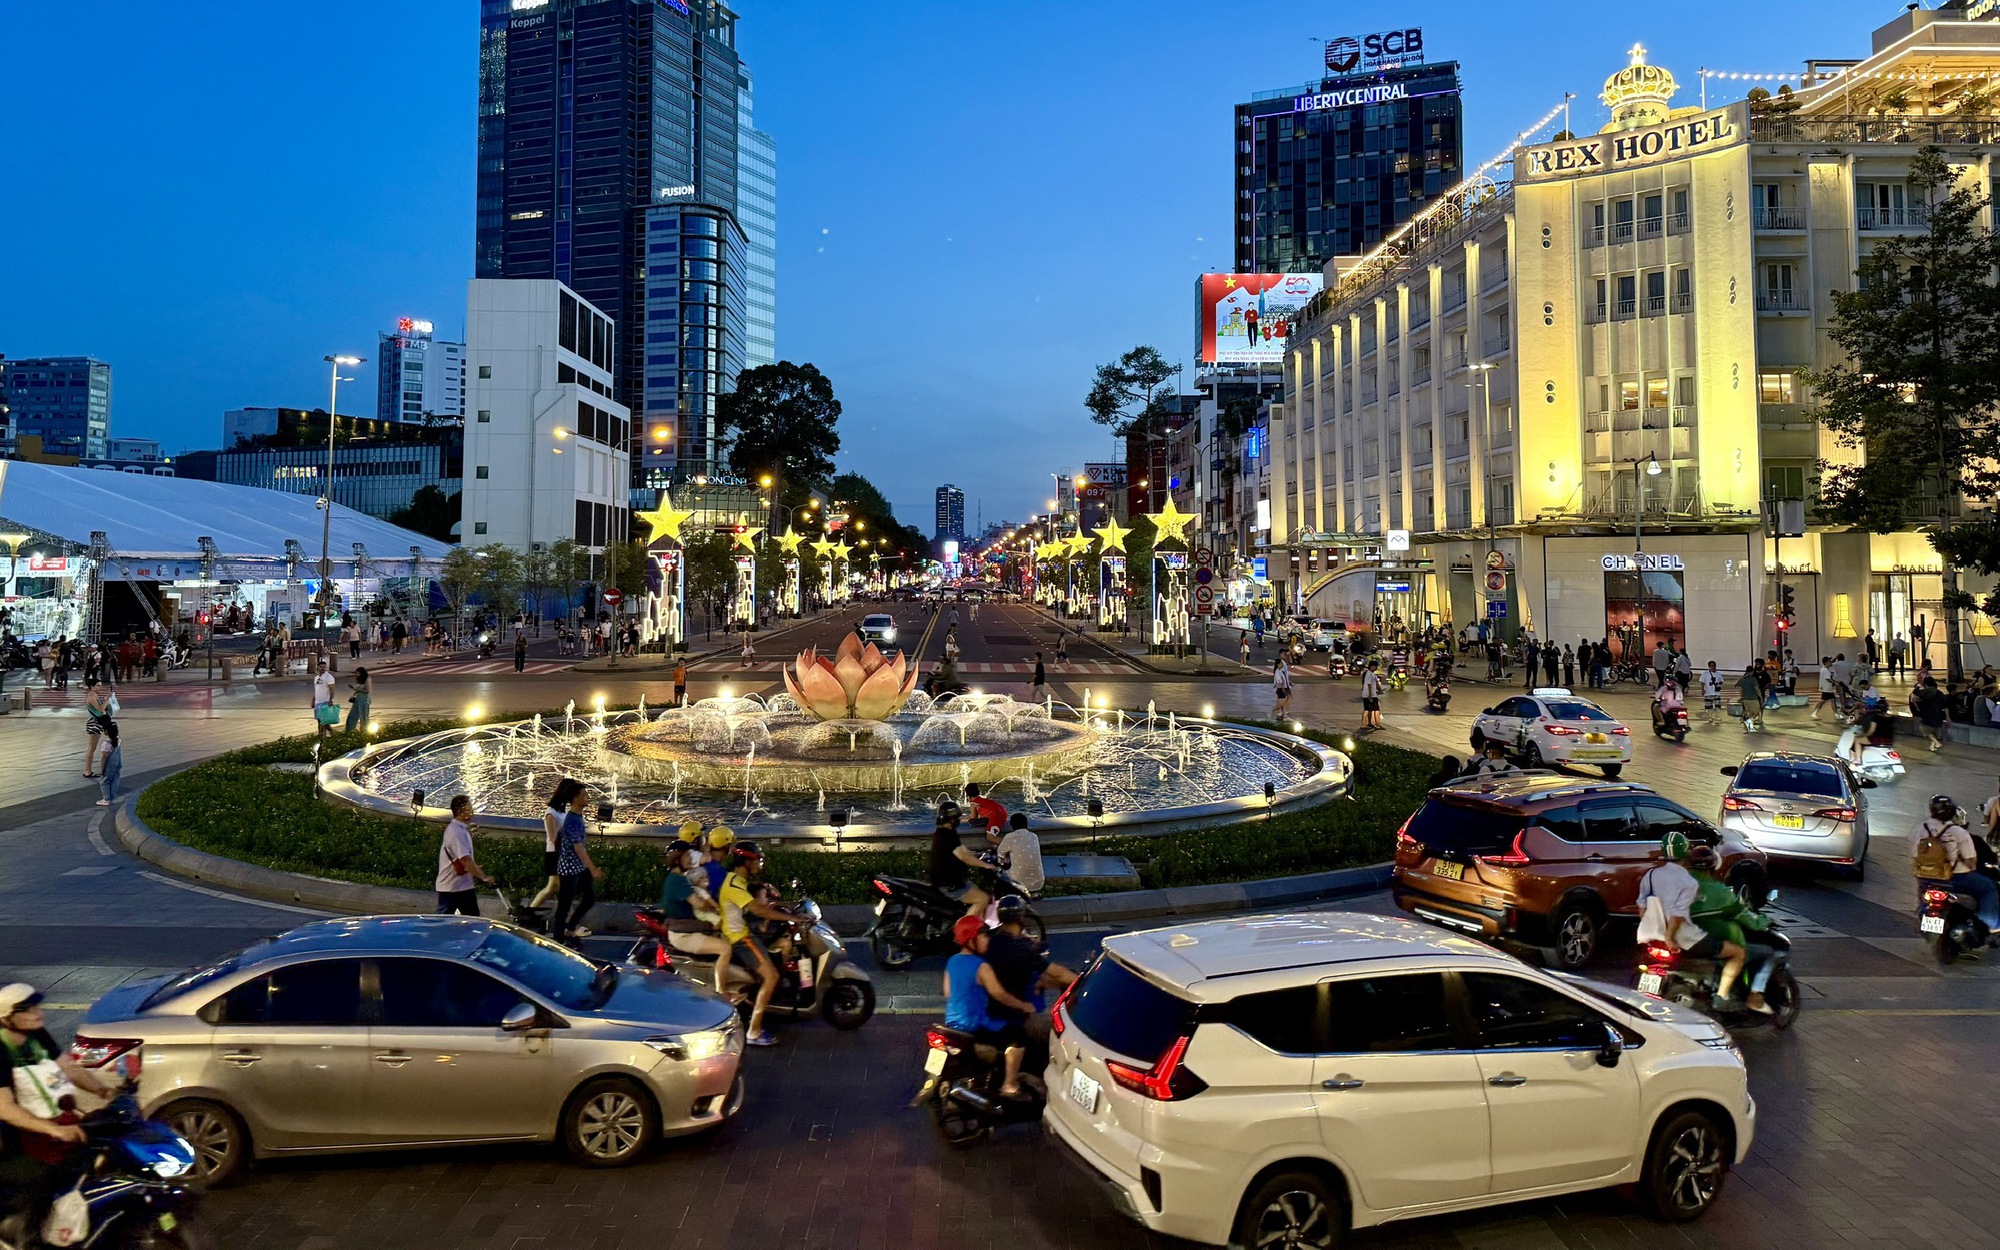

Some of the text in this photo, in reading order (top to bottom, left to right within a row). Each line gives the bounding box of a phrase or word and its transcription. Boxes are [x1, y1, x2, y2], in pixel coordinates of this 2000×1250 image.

[511, 14, 545, 28] Keppel
[1364, 28, 1423, 58] SCB
[1294, 84, 1409, 111] LIBERTY CENTRAL
[1530, 114, 1733, 173] REX HOTEL
[661, 185, 694, 197] FUSION
[413, 321, 434, 333] MB
[410, 340, 428, 350] MB
[1602, 555, 1684, 569] CHNEL
[1893, 563, 1940, 572] CHANEL
